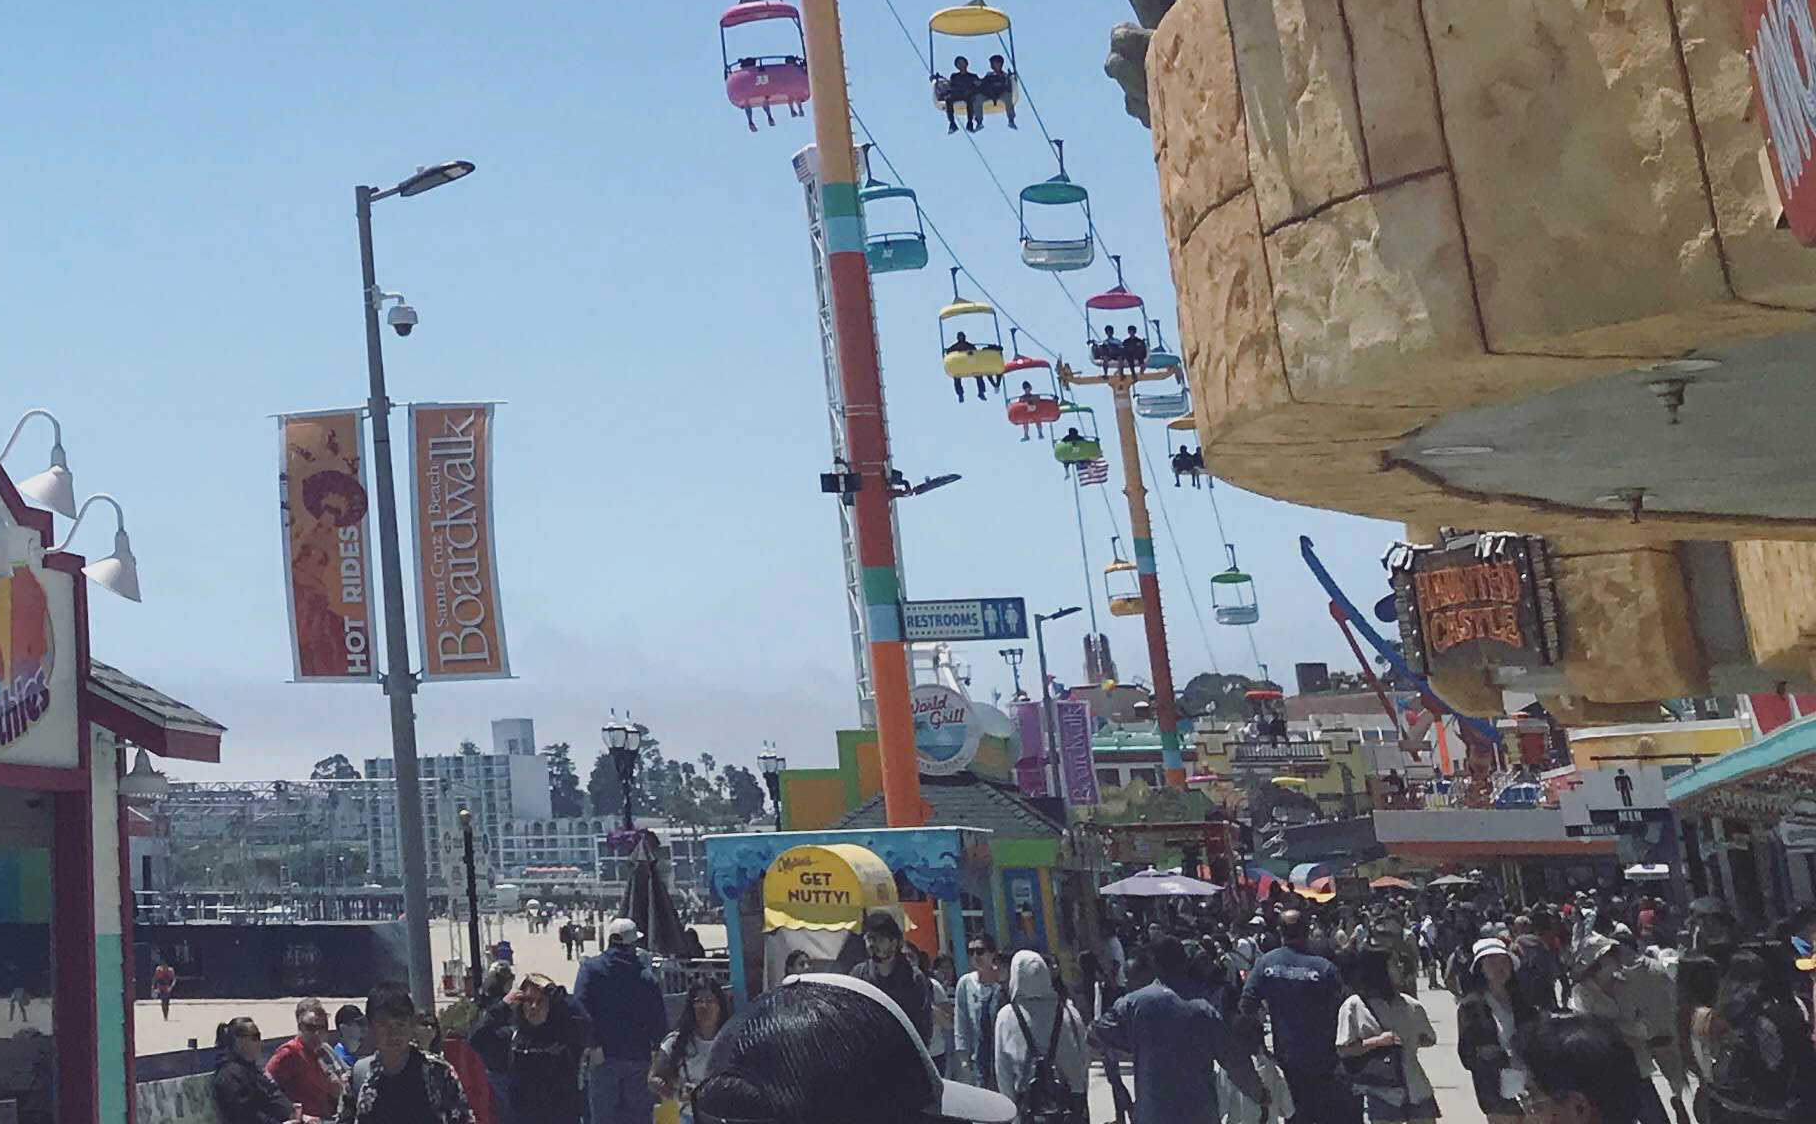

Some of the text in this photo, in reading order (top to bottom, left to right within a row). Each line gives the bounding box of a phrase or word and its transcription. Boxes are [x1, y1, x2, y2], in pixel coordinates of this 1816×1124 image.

[426, 464, 449, 628] Santa Cruz Beach
[428, 410, 491, 672] Boardwalk
[338, 525, 368, 673] HOT RIDES
[906, 613, 978, 628] RESTROOMS
[1430, 605, 1521, 653] CASTLE
[930, 708, 965, 730] Grill
[1618, 811, 1643, 822] MEN
[800, 872, 833, 886] GET
[788, 890, 851, 904] NUTTY!
